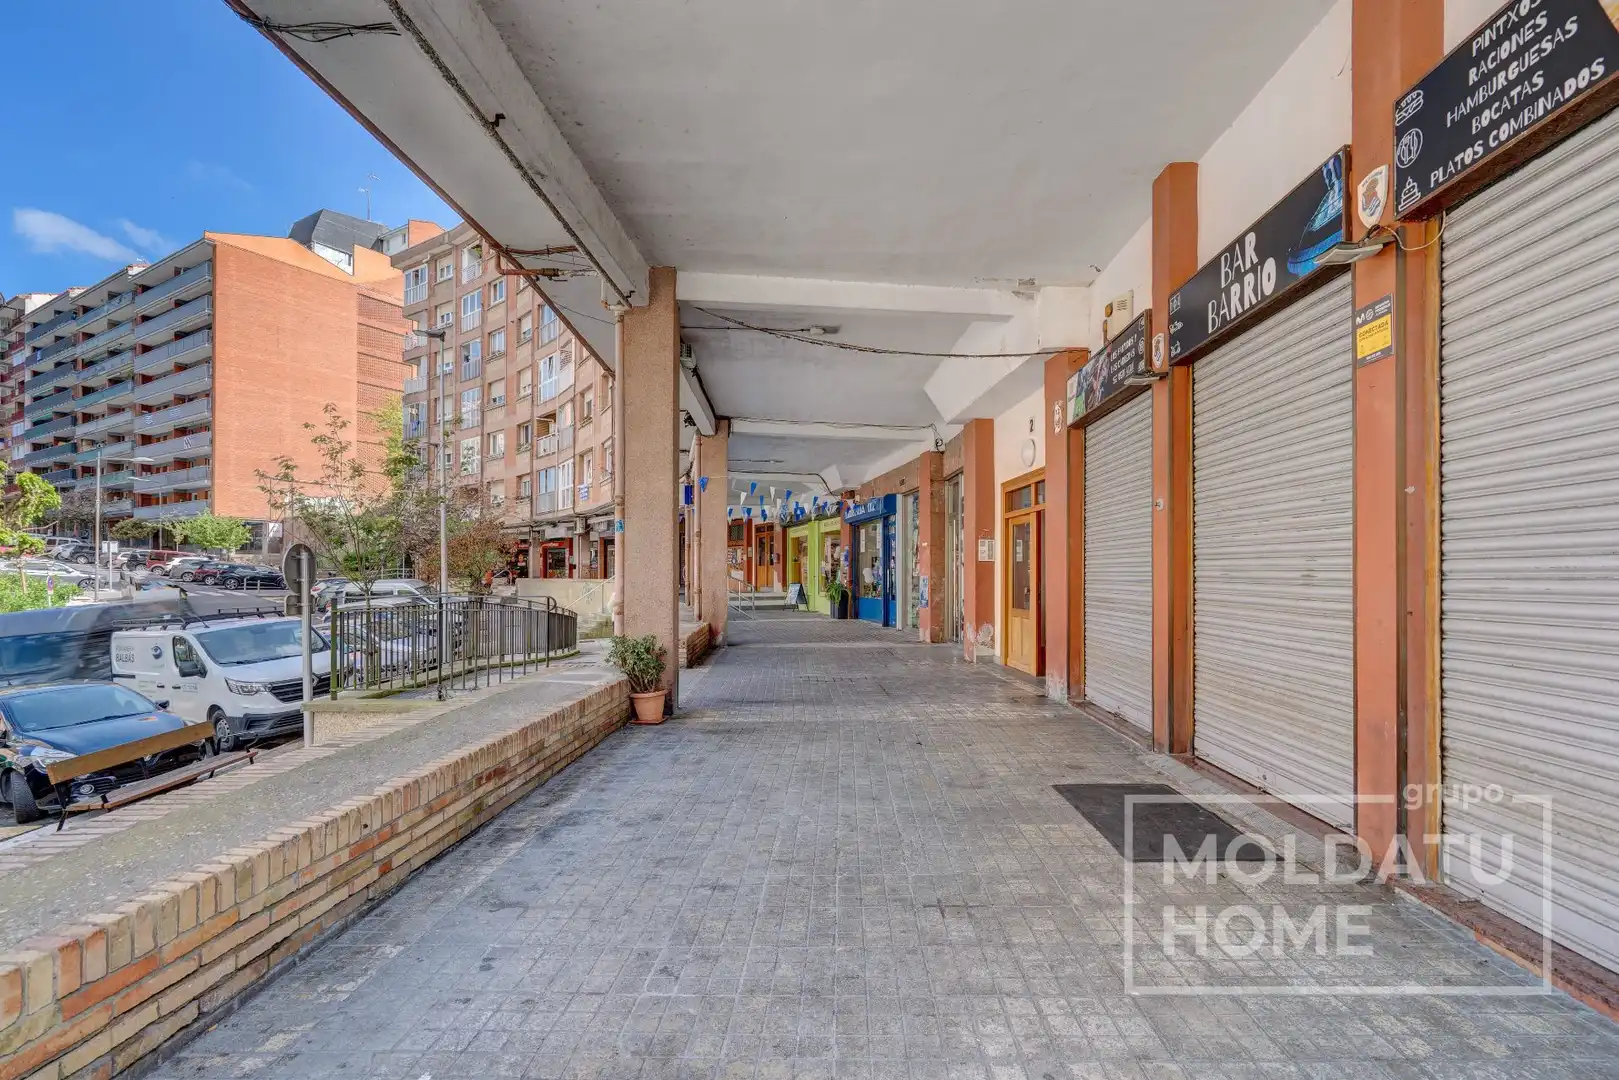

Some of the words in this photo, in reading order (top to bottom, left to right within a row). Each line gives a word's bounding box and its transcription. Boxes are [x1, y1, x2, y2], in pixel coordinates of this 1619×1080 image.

[1447, 16, 1578, 128] HAMBURGUESAS
[1468, 11, 1547, 86] RACIONES
[1430, 140, 1484, 188] PLATOS
[1488, 57, 1605, 147] COMBINADOS
[1472, 70, 1544, 135] BOCATAS
[1208, 257, 1276, 333] BARRIO
[1221, 232, 1259, 288] BAR
